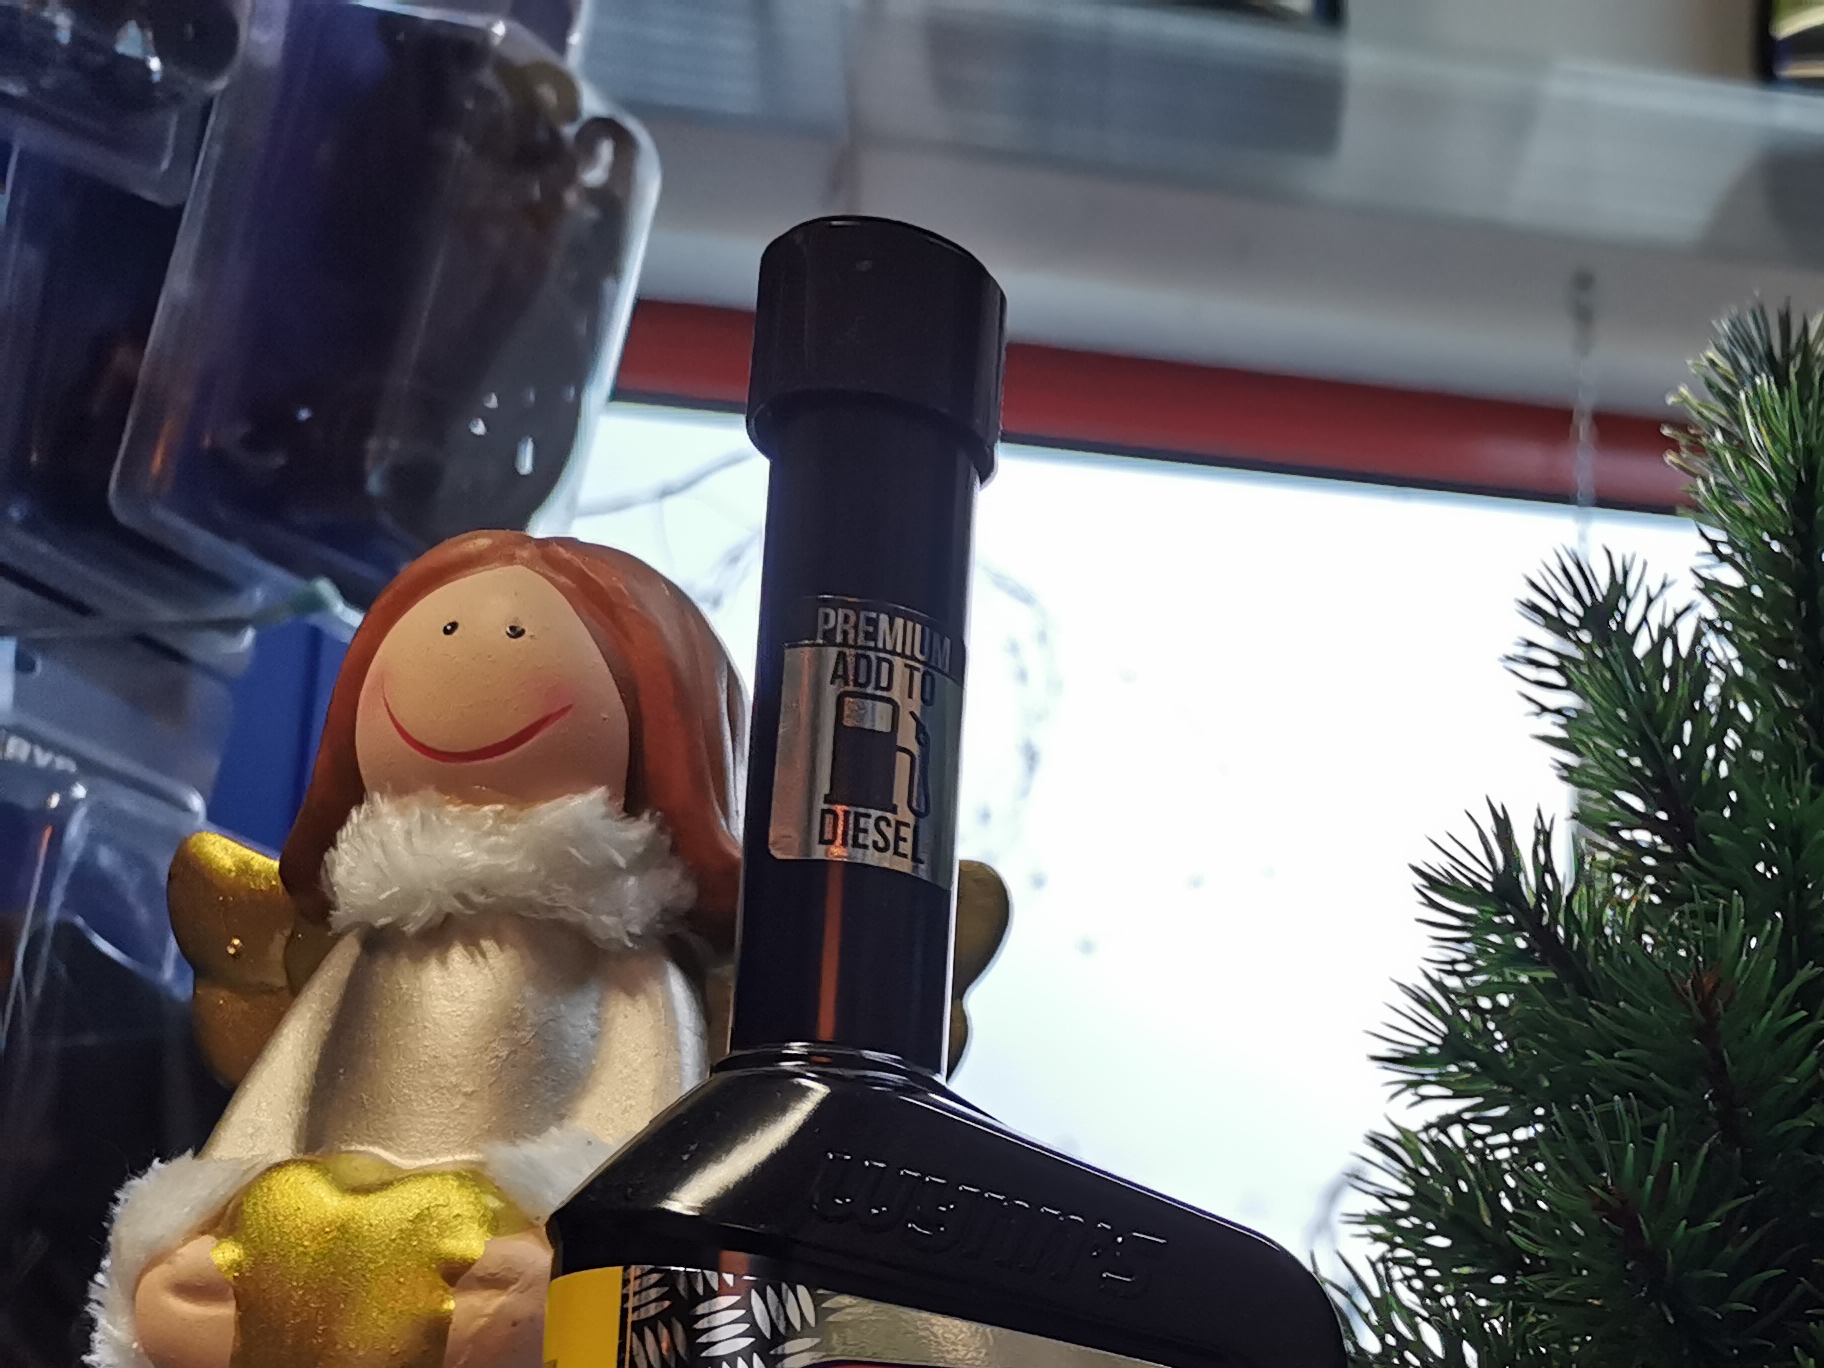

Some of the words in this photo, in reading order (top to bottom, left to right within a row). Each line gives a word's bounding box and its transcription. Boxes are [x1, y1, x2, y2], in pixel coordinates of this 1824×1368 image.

[817, 606, 951, 673] PREMIUM
[830, 652, 893, 692] ADD
[905, 662, 935, 707] TO
[817, 807, 925, 866] DIESEL
